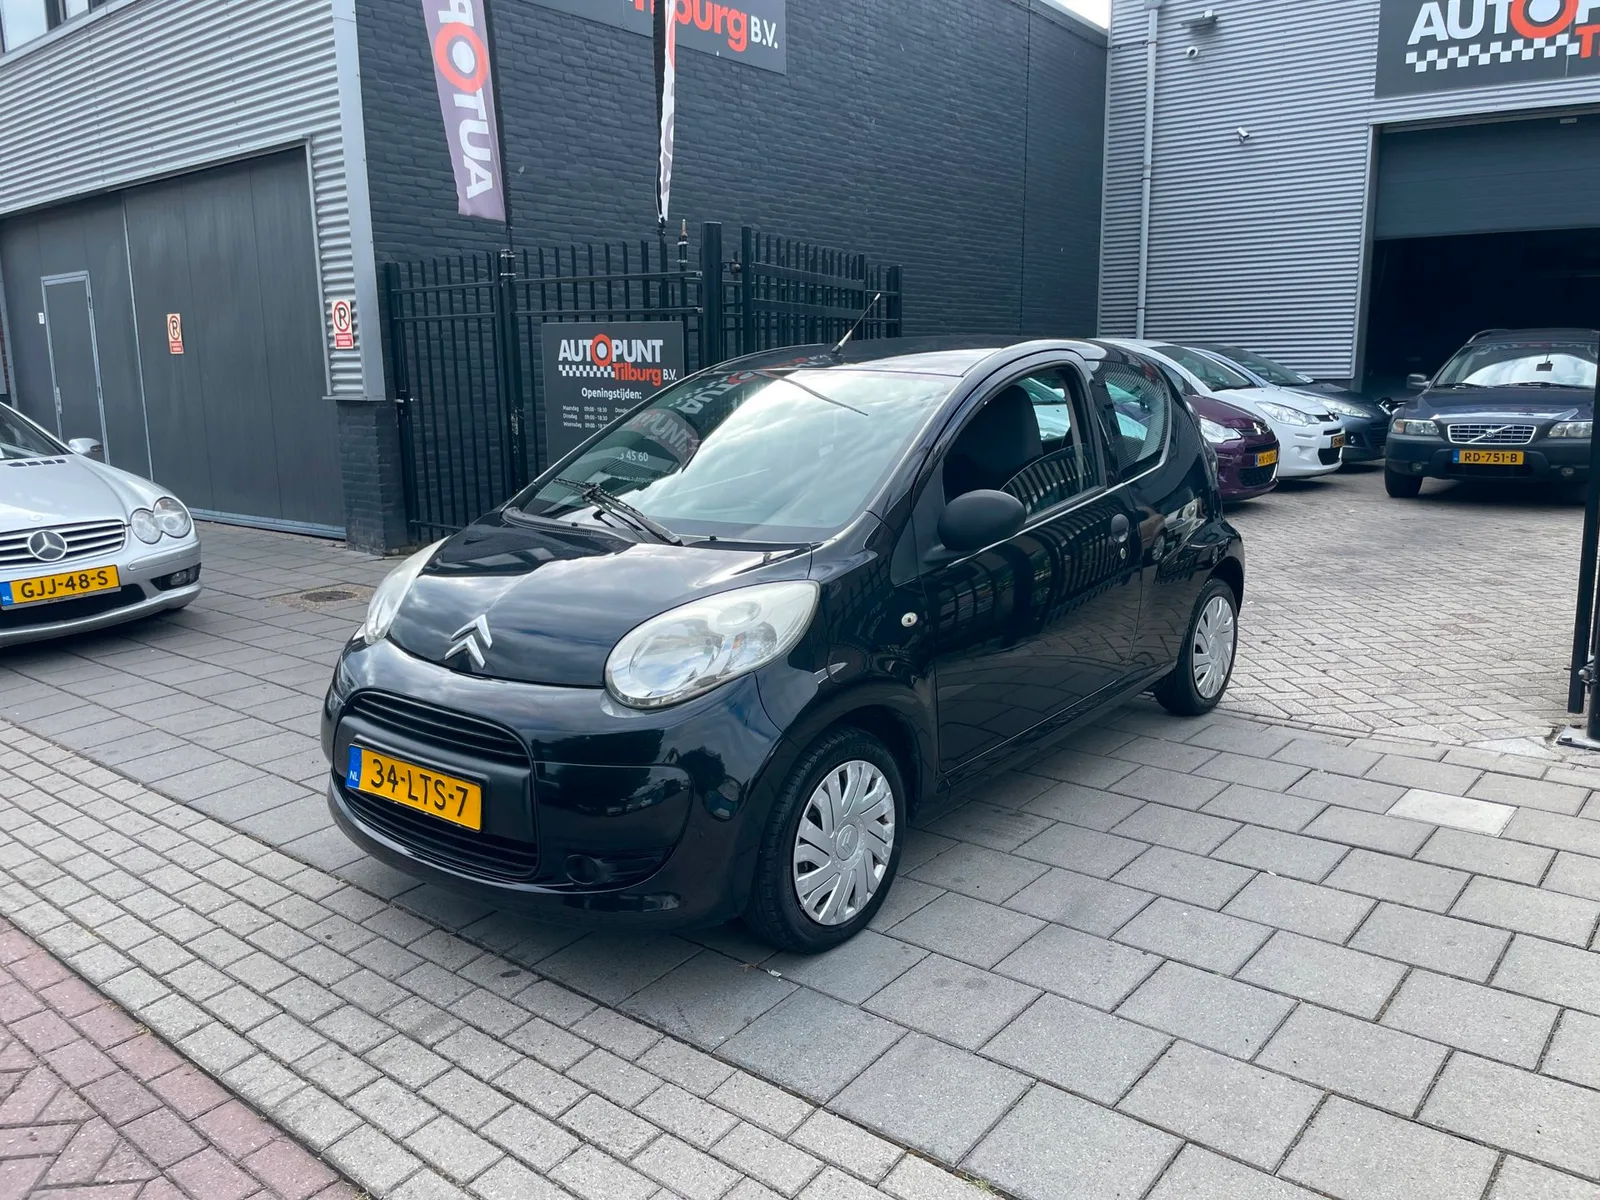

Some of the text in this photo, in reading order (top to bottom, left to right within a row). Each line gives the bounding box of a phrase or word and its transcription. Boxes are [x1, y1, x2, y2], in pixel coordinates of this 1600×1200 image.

[750, 15, 779, 50] B.V.
[558, 333, 664, 367] AUTOPUNT
[612, 362, 677, 387] Tilburg B.V.
[581, 387, 642, 401] Openingstijden:
[562, 405, 580, 413] Maandag
[626, 450, 637, 461] 45
[638, 451, 649, 462] 60
[1464, 452, 1518, 463] RD-751-B
[21, 570, 109, 598] GJJ-48-S
[349, 770, 359, 782] NL
[371, 758, 469, 818] 34-LTS-7
